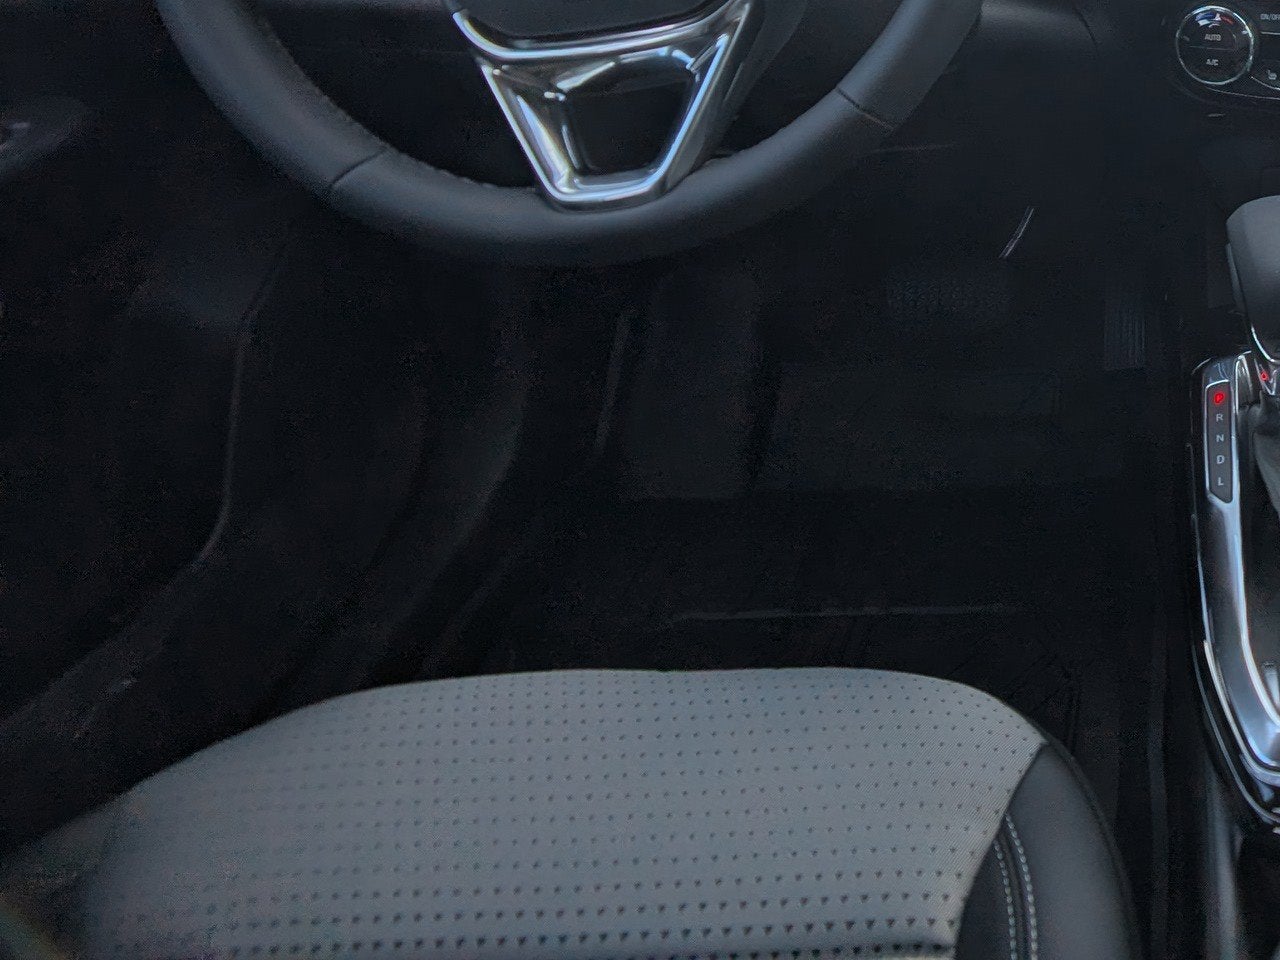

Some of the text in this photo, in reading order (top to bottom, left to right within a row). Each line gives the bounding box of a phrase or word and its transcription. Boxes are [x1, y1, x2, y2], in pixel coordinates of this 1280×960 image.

[1204, 33, 1222, 41] AUTO
[1205, 58, 1219, 66] A/C
[1215, 392, 1225, 404] P
[1216, 413, 1224, 422] R
[1216, 434, 1224, 442] N
[1216, 455, 1225, 464] D
[1217, 476, 1224, 486] L
